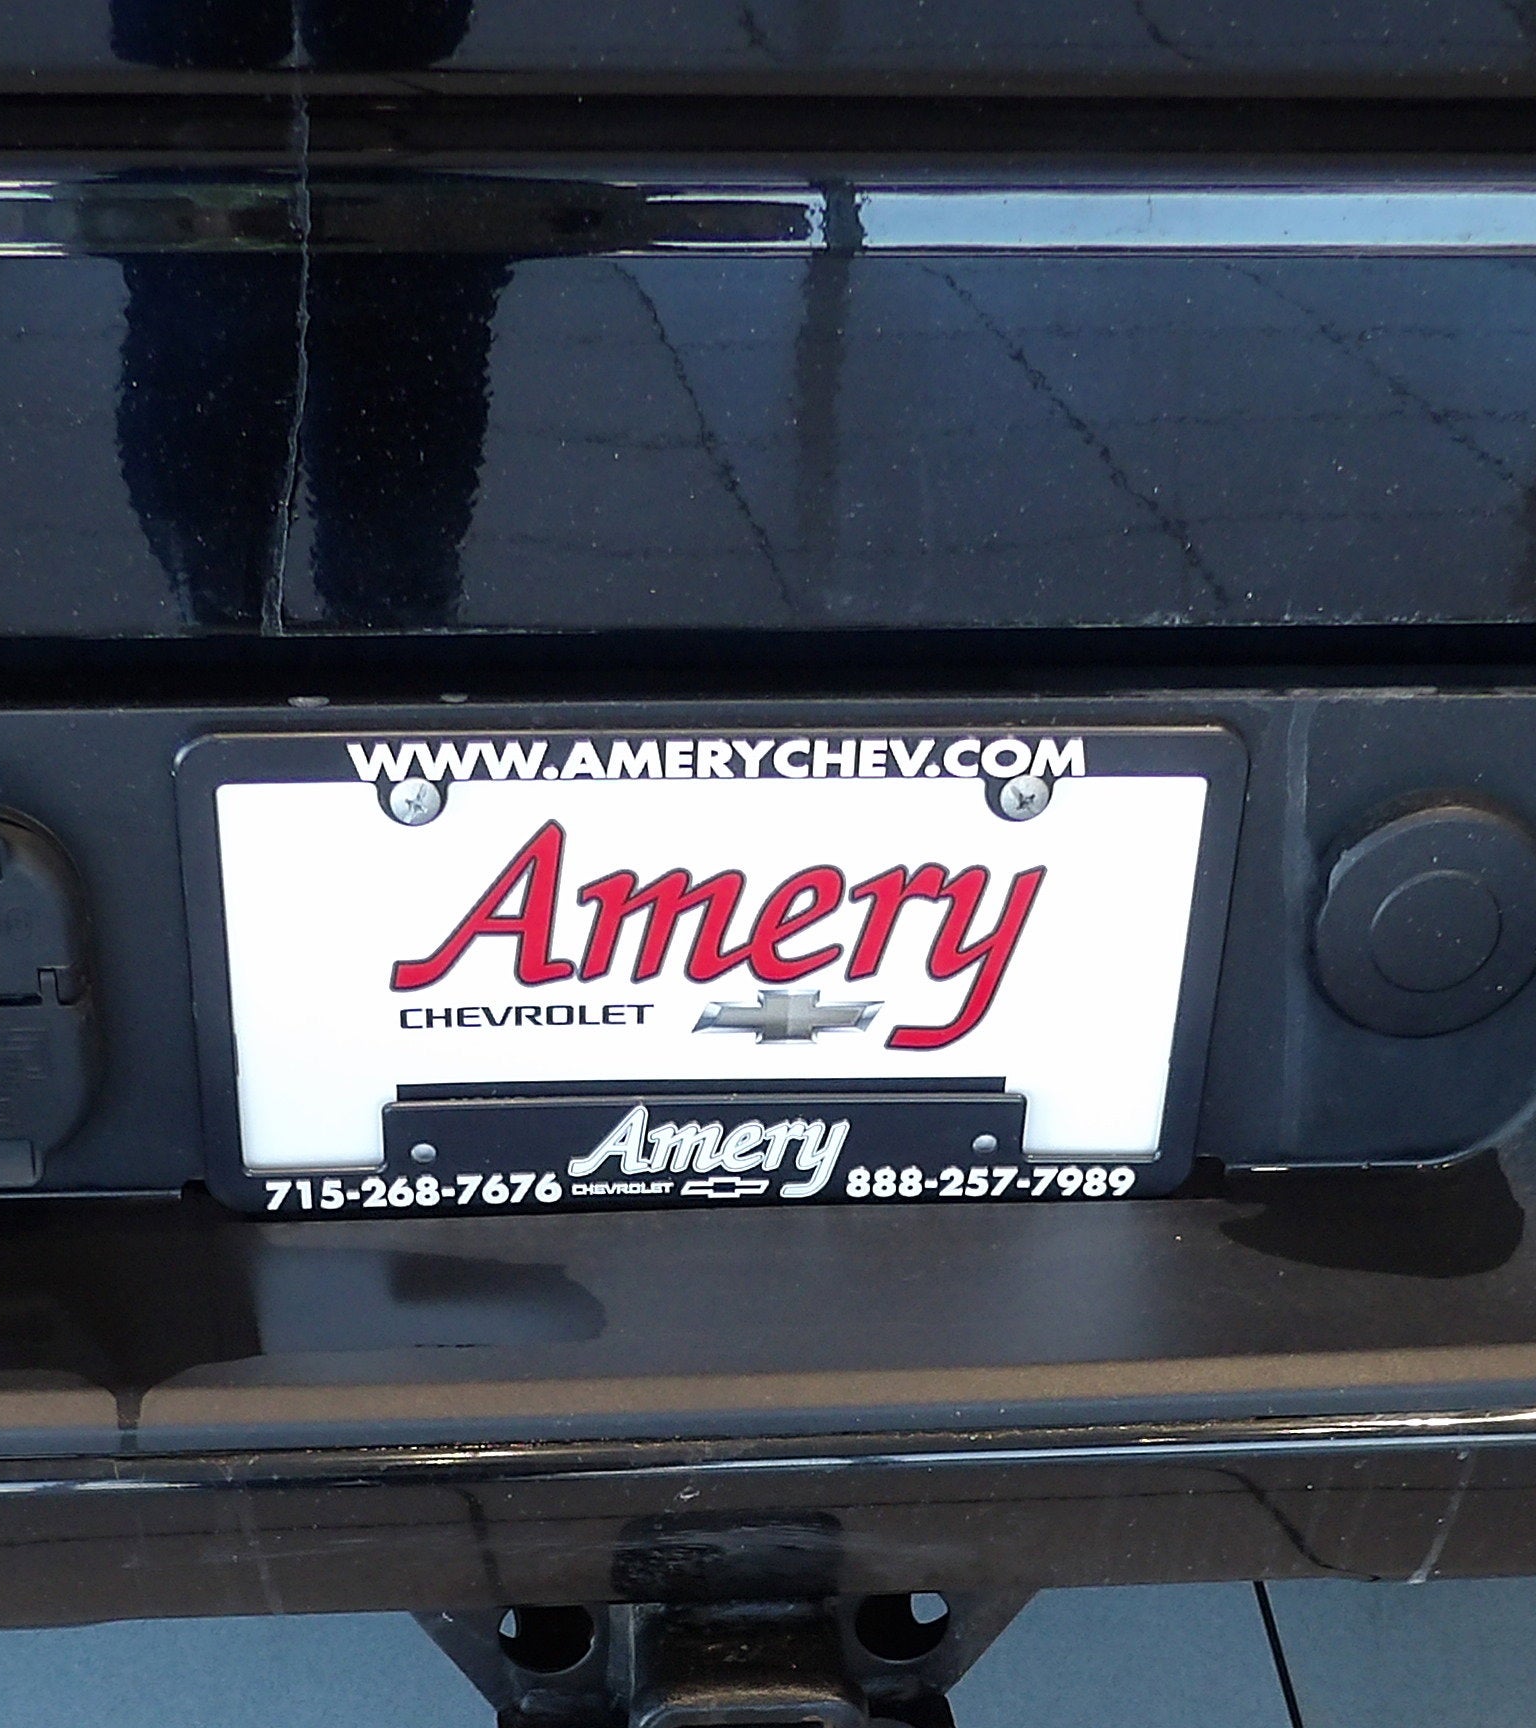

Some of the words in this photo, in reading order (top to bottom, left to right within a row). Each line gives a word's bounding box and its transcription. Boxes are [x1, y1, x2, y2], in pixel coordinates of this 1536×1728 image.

[349, 739, 1087, 779] WWW.AMERYCHEV.COM
[389, 818, 1047, 1051] Amery
[399, 1003, 654, 1030] CHEVROLET
[567, 1104, 850, 1198] Amery
[265, 1172, 563, 1211] 715-268-7676
[571, 1180, 674, 1196] CHEVROLET
[845, 1165, 1136, 1198] 888-257-7989
